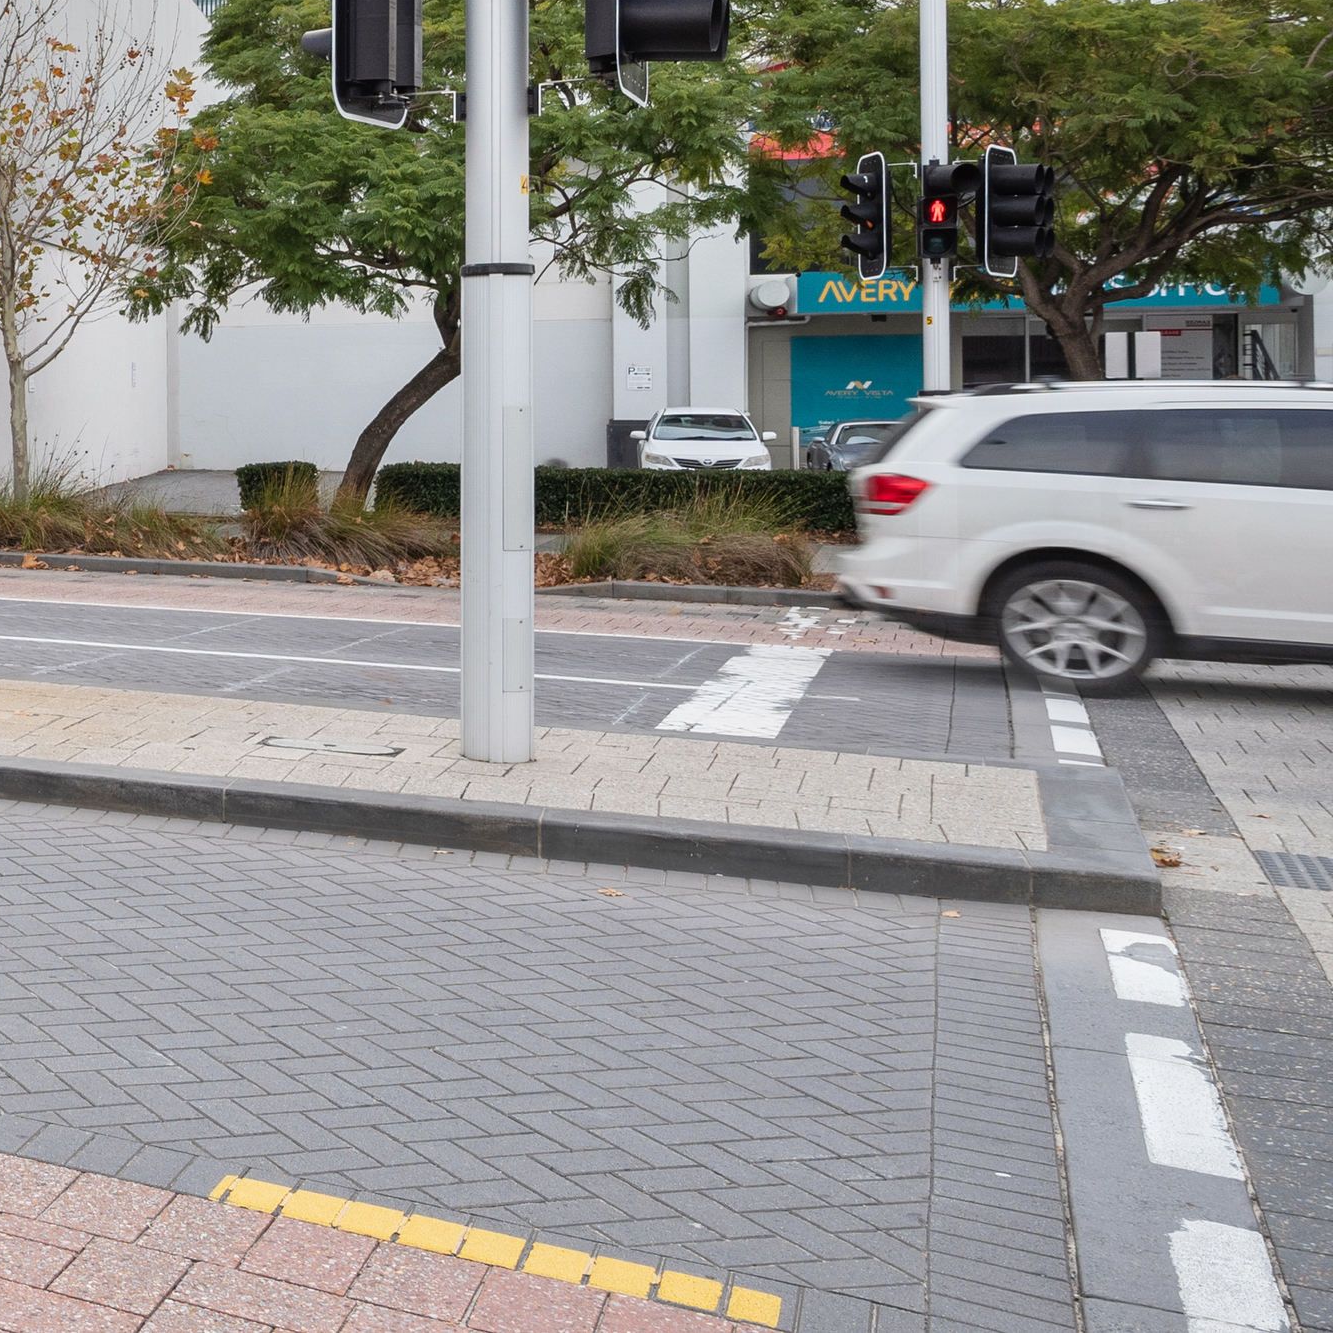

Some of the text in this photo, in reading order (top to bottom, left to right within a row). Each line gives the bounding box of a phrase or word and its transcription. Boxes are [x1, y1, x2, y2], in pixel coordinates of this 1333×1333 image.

[818, 280, 917, 303] AVERY
[926, 316, 933, 325] 5
[628, 367, 635, 375] P
